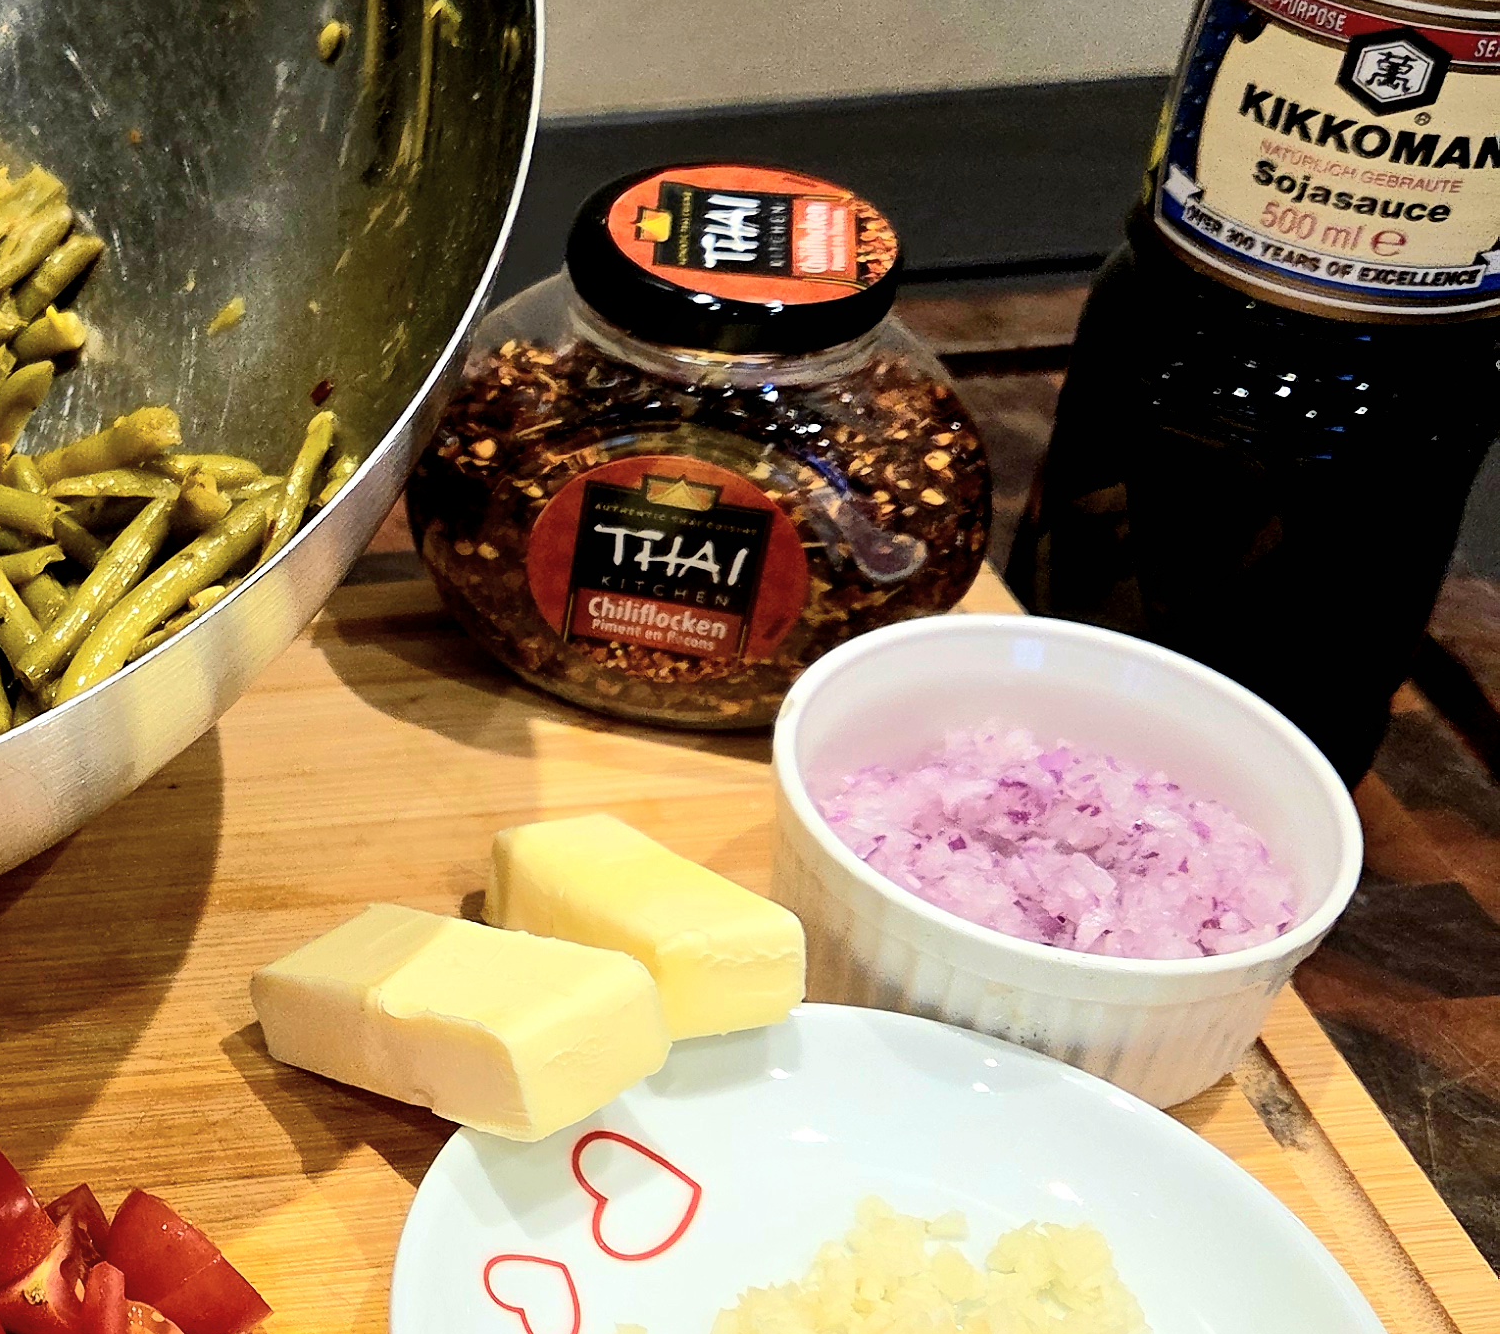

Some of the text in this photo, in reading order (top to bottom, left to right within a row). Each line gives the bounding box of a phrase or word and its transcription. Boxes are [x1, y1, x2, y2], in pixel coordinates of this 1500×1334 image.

[1238, 82, 1500, 170] KIKKOMAN
[1252, 159, 1451, 223] Sojasauce
[701, 193, 761, 269] THAI
[1260, 200, 1318, 241] 500
[1322, 223, 1364, 251] ml
[1326, 261, 1353, 277] OF
[1356, 266, 1481, 286] EXCELLENCE
[593, 522, 749, 586] THAI
[601, 574, 731, 607] KITCHEN
[587, 596, 728, 640] Chiliflocken
[591, 618, 642, 638] Piment
[644, 628, 663, 643] en
